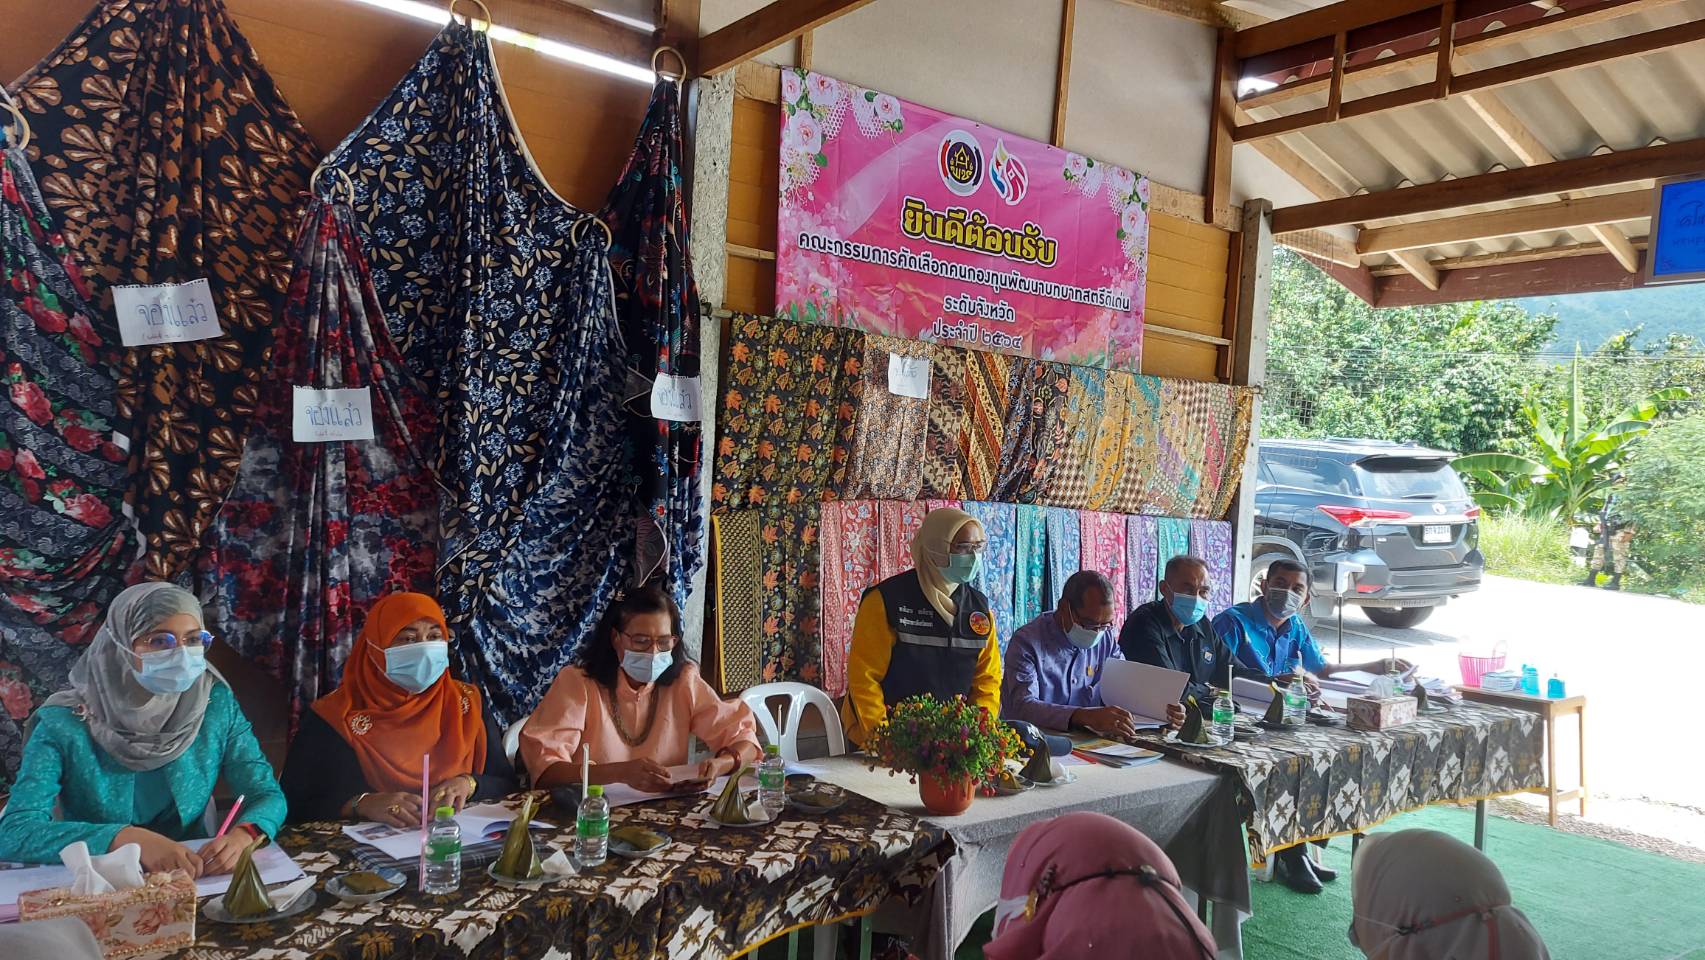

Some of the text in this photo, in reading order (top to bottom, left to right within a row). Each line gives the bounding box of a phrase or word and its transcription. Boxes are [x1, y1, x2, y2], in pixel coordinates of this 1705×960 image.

[902, 197, 1057, 266] ยินดีต้อนรับ
[799, 232, 1130, 311] คณะกรรมการคัดเลือกคนกองทุนพัฒนาบทบาทสตรีดีเด่น
[933, 318, 978, 343] ประจำปี
[944, 294, 1016, 321] ระดับจังหวัด
